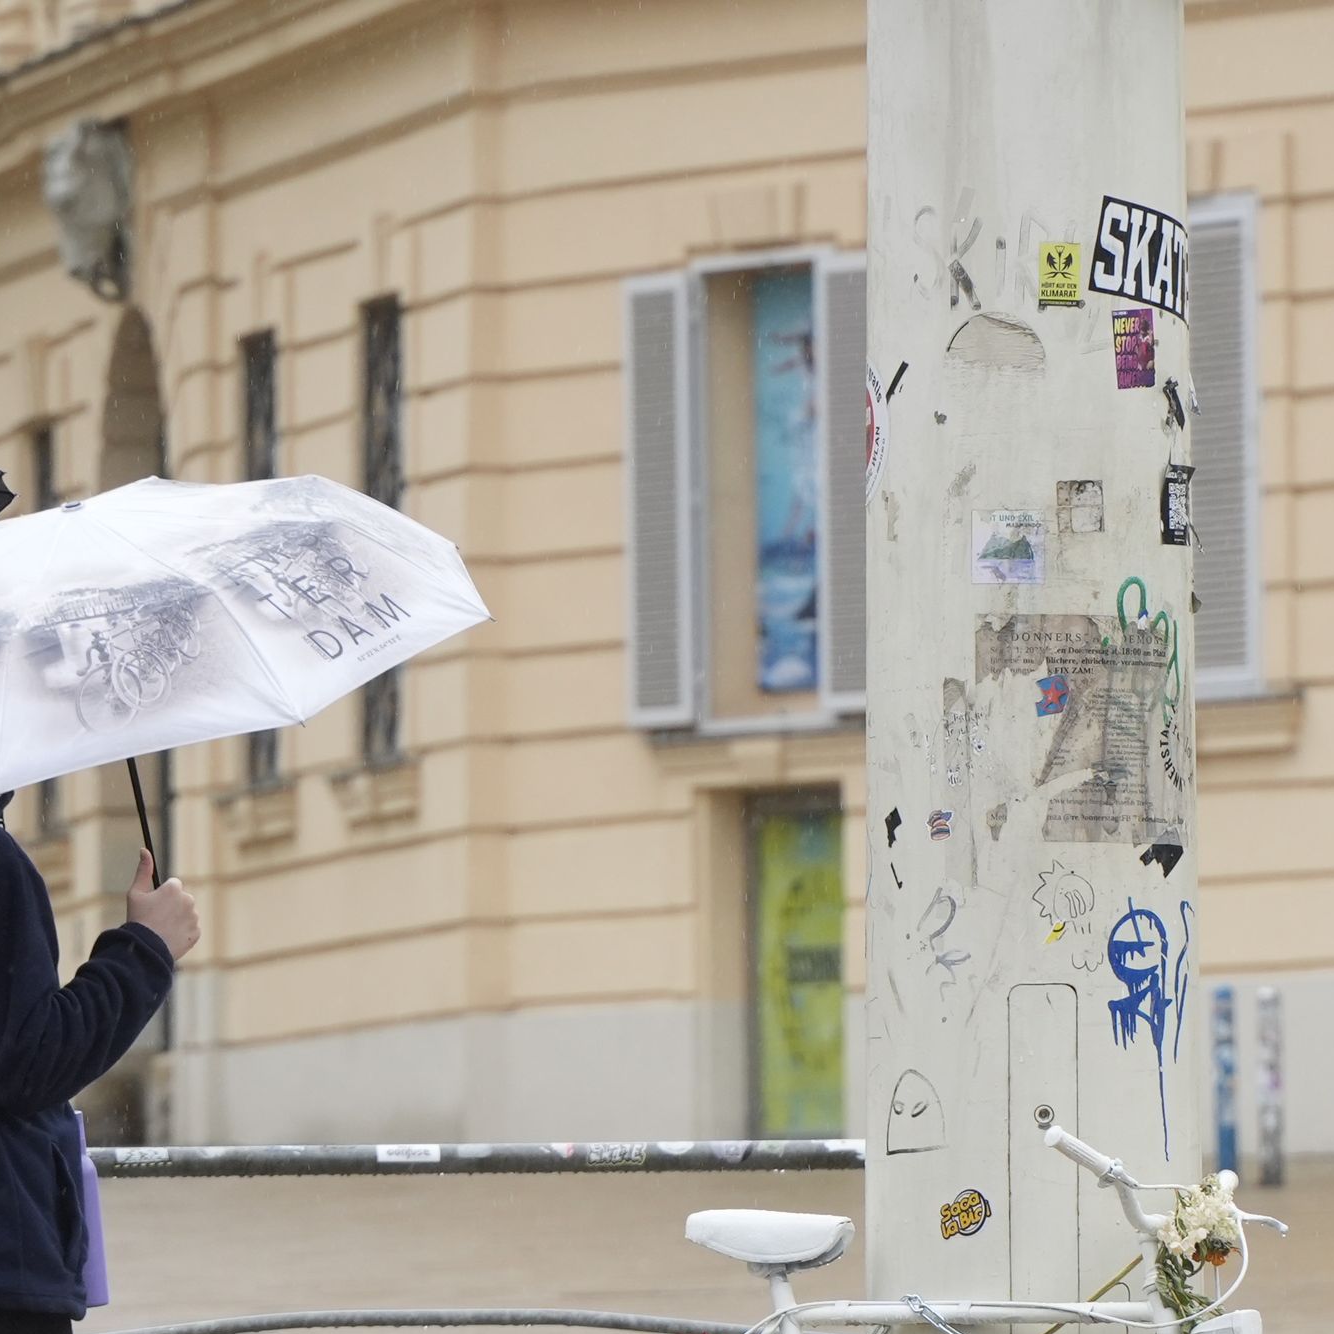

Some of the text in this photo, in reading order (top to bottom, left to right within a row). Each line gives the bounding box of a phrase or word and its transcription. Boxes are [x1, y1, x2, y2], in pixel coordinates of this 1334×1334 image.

[1094, 201, 1188, 318] SKAT
[1040, 290, 1077, 298] KLIMARAT
[1114, 317, 1140, 334] NEVER
[1115, 336, 1137, 353] STOP
[256, 557, 369, 620] TER
[307, 593, 411, 660] DAM
[940, 1193, 981, 1223] Saca
[941, 1220, 959, 1239] la
